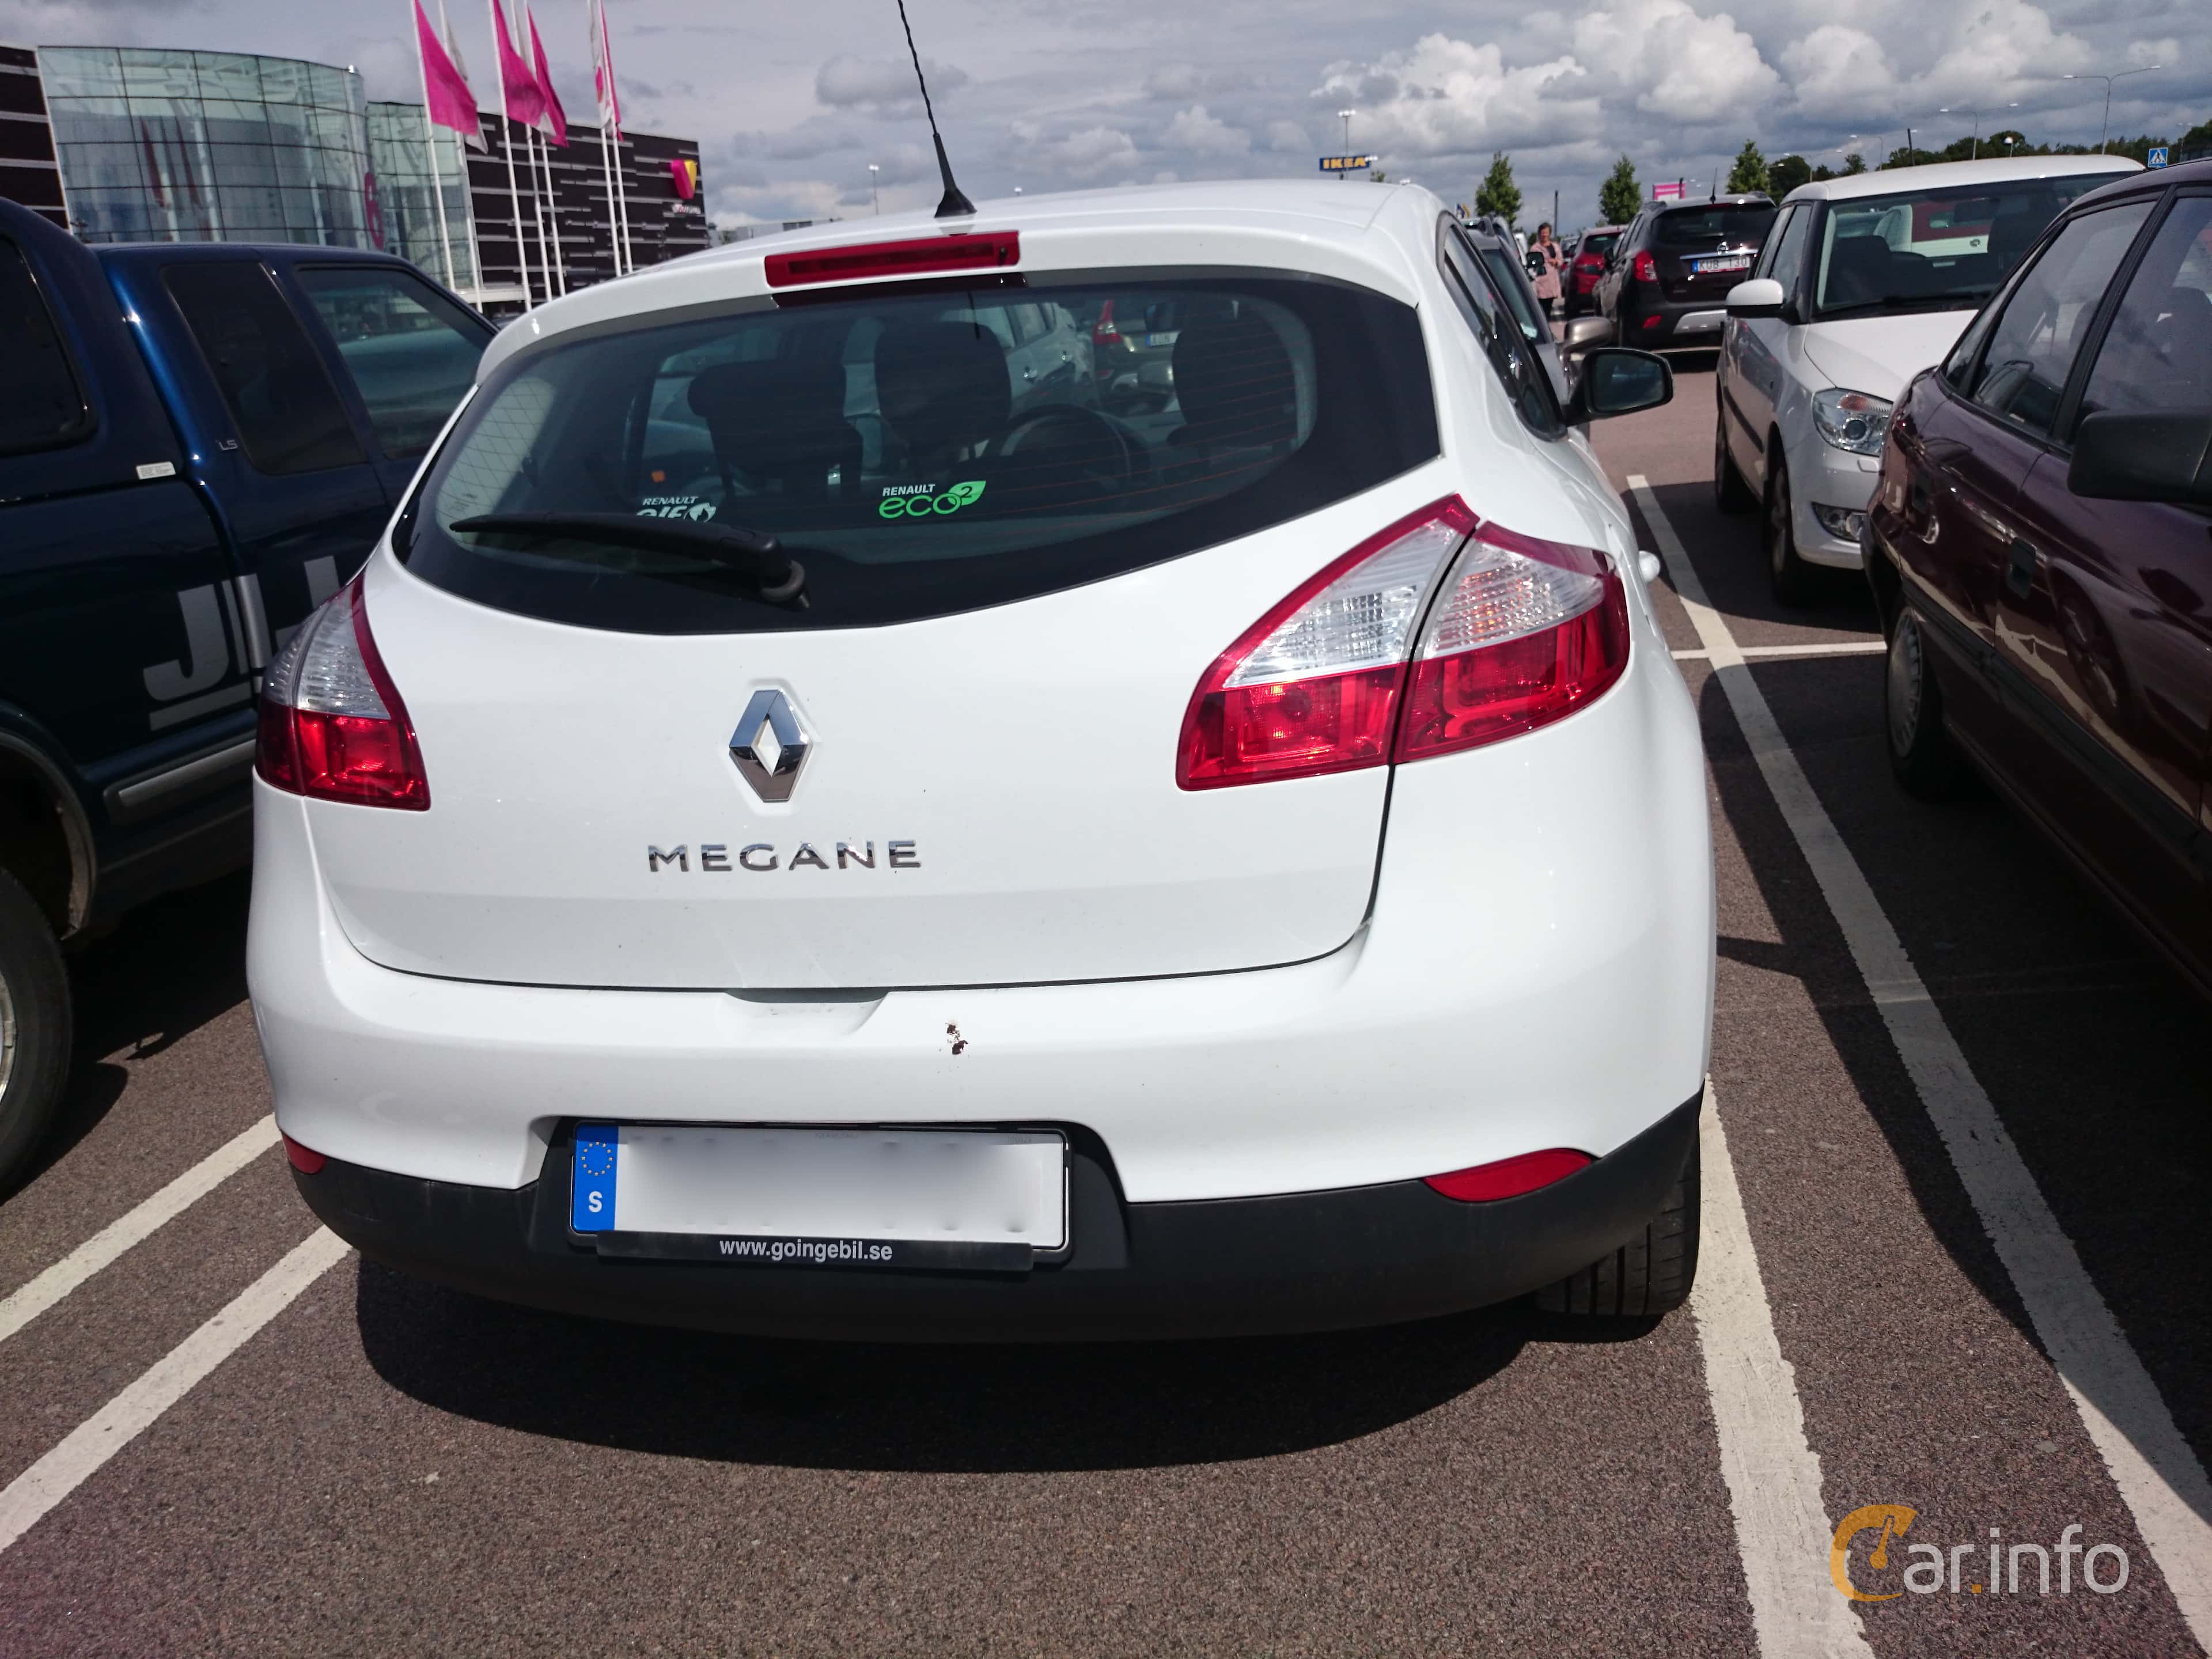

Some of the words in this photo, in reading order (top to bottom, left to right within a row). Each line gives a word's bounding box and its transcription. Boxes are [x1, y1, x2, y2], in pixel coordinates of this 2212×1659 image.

[1323, 156, 1366, 169] IKEA
[218, 439, 238, 450] LS
[882, 484, 935, 497] RENAULT
[642, 496, 699, 506] RENAULT
[647, 840, 922, 873] MEGANE
[589, 1190, 603, 1213] S
[719, 1238, 893, 1263] www.goingebil.se
